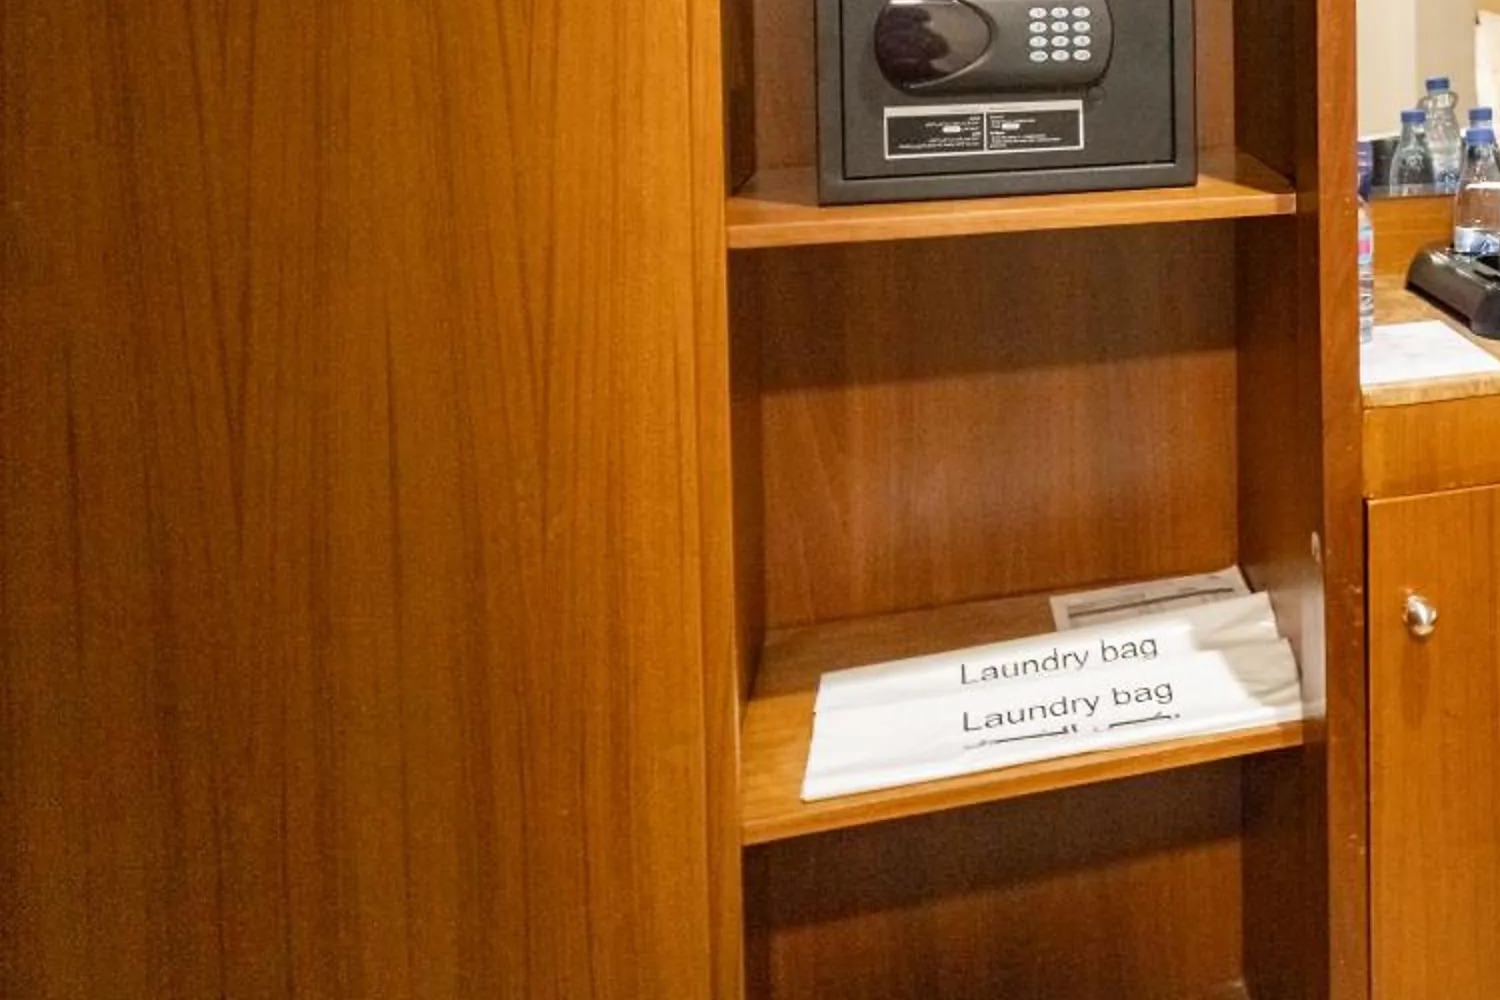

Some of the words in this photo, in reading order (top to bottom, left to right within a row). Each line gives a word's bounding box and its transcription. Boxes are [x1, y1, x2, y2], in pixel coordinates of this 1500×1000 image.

[960, 647, 1089, 685] Laundry
[1100, 637, 1158, 663] bag
[962, 695, 1100, 732] Laundry
[1111, 682, 1174, 705] bag
